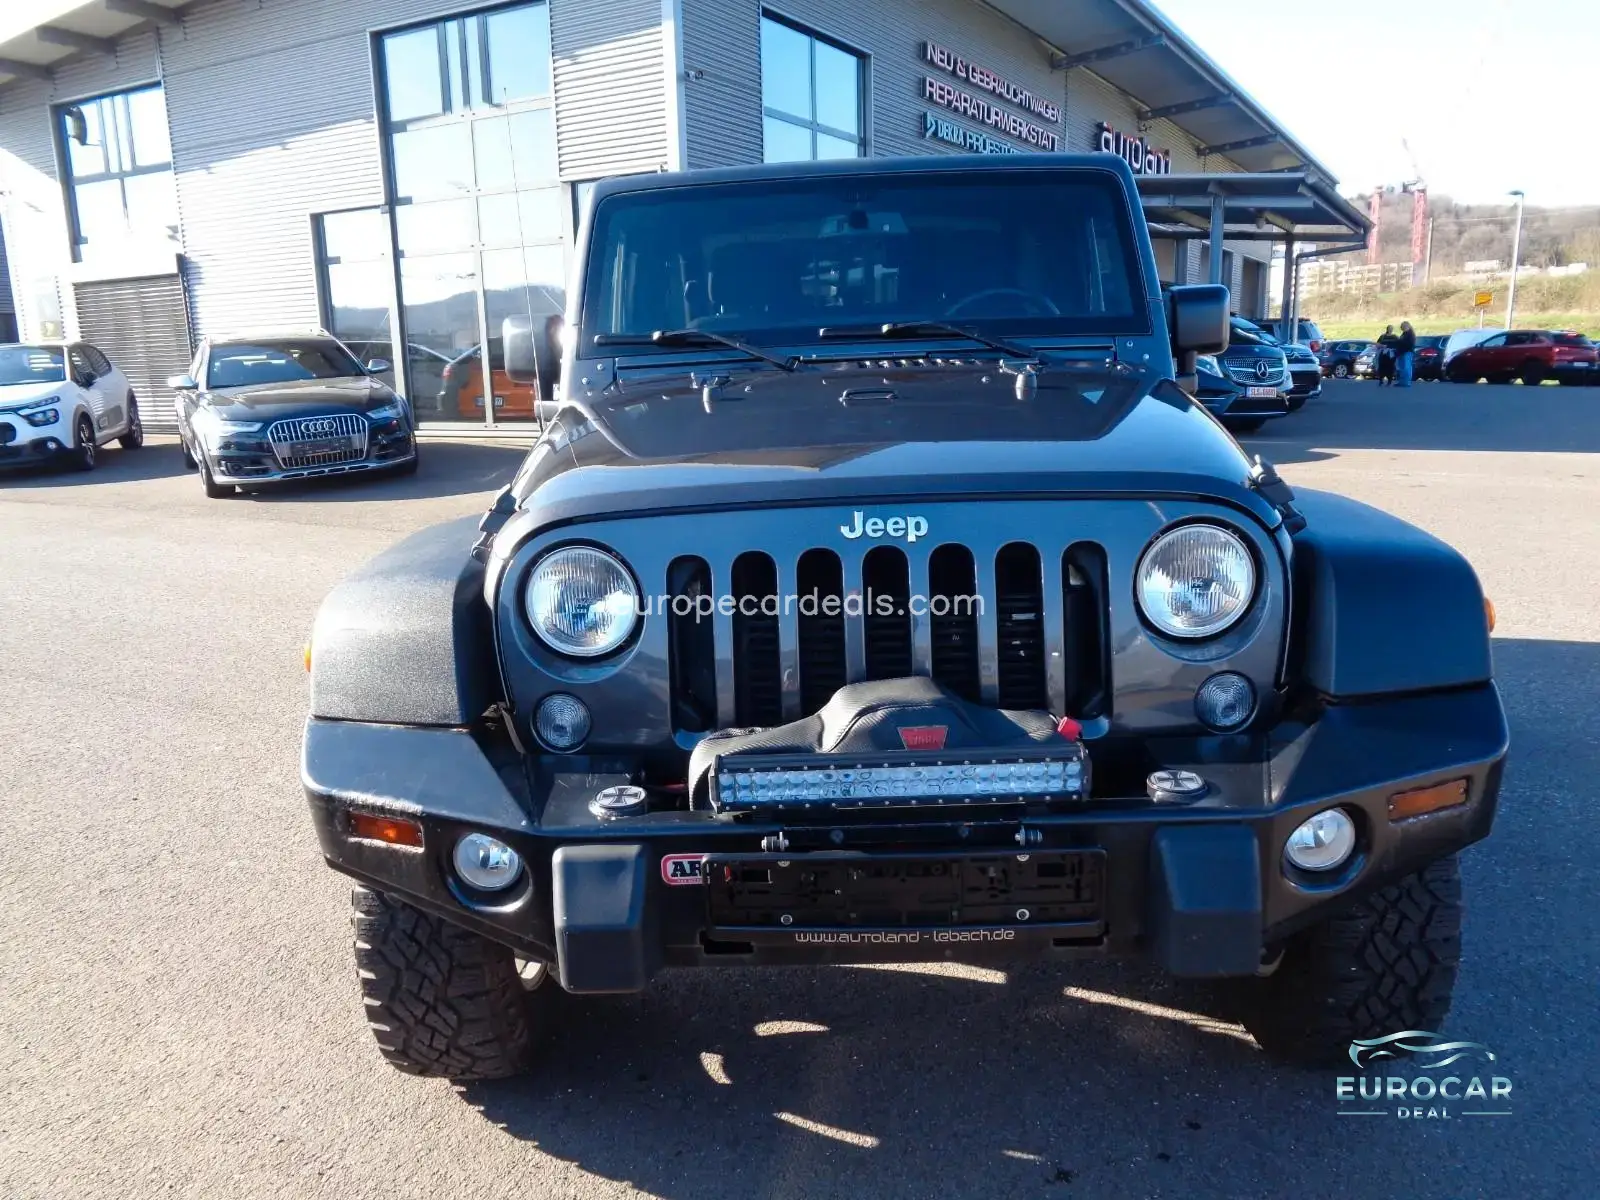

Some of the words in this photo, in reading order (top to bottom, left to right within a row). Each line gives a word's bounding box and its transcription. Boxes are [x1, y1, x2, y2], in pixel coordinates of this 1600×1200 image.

[926, 40, 954, 71] NEU
[956, 56, 967, 78] &
[969, 63, 1062, 124] GEBRAUCHTWAGEN
[925, 76, 1060, 152] REPARATURWERKSTATT
[937, 118, 965, 146] DEKRA
[840, 510, 929, 542] Jeep
[670, 860, 703, 878] AR
[795, 930, 920, 943] www.autoland
[933, 928, 1015, 942] lebach.de
